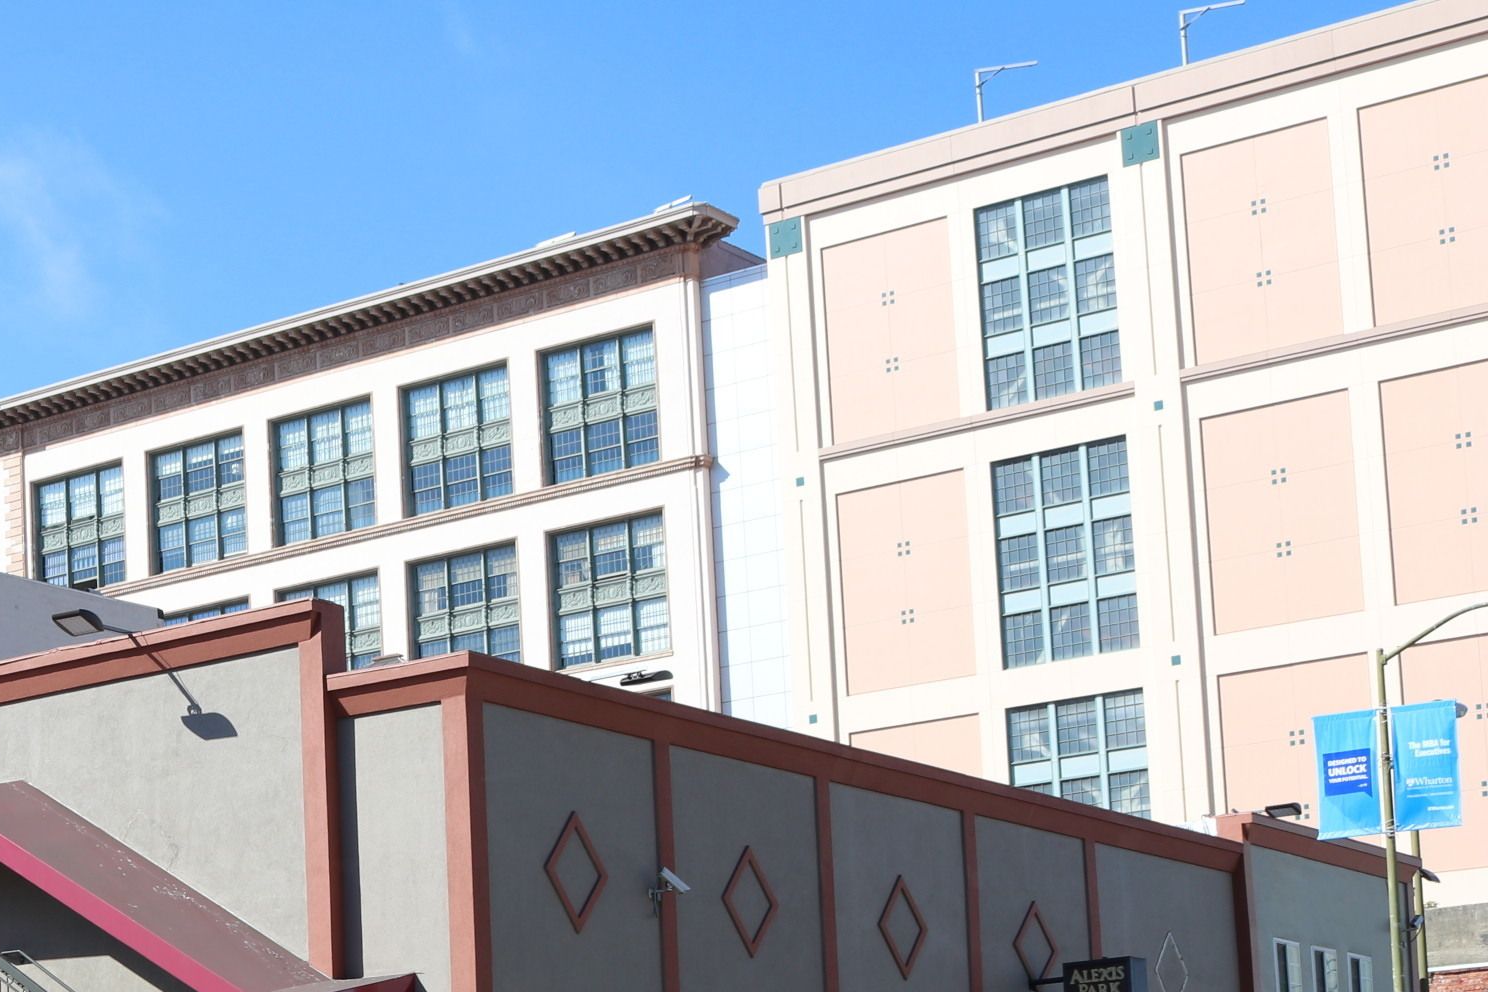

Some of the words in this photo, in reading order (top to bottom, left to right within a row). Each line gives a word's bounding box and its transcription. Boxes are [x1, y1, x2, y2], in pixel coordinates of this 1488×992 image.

[1328, 757, 1357, 767] DESIGNED
[1357, 755, 1367, 763] TO
[1328, 764, 1367, 777] UNLOCK
[1415, 777, 1452, 786] Wharton
[1070, 966, 1125, 984] ALEXIS
